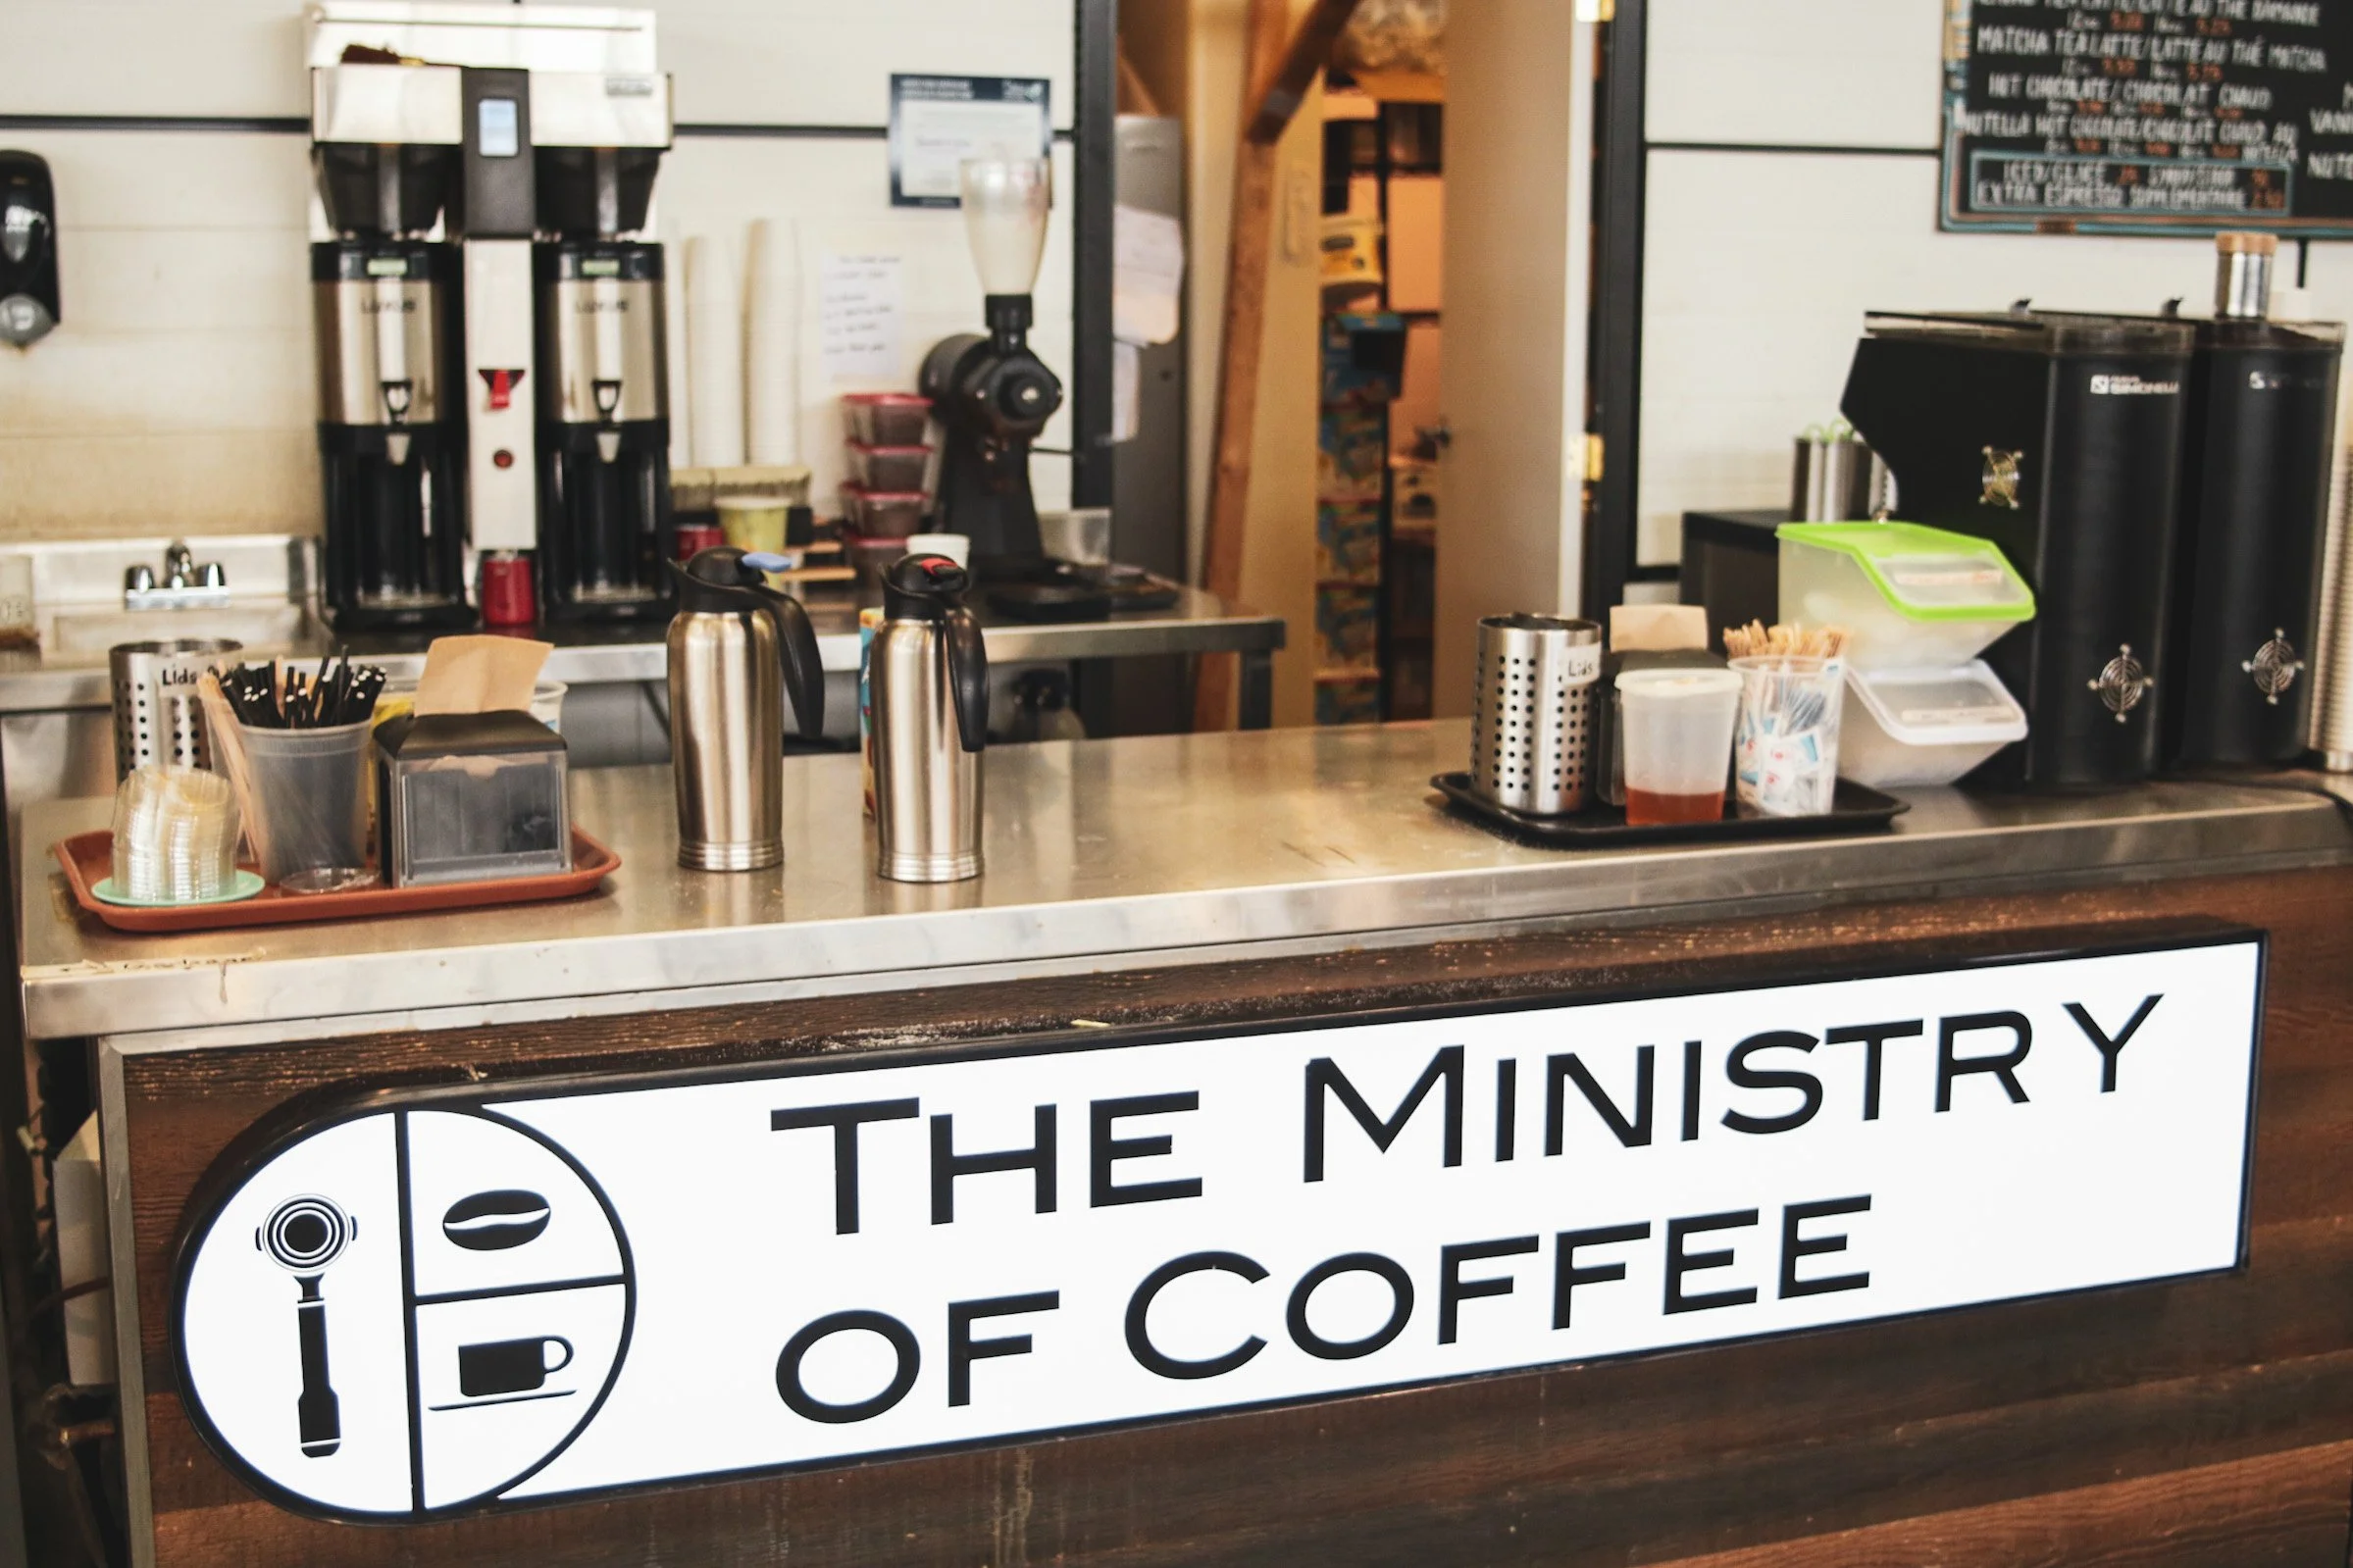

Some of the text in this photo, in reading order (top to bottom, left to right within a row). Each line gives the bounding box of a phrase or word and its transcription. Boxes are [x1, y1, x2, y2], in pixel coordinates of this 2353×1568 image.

[1976, 25, 2050, 55] MATCHA
[162, 668, 197, 685] Lids
[771, 993, 2165, 1236] THE MINISTRY
[775, 1193, 1872, 1424] OF COFFEE
